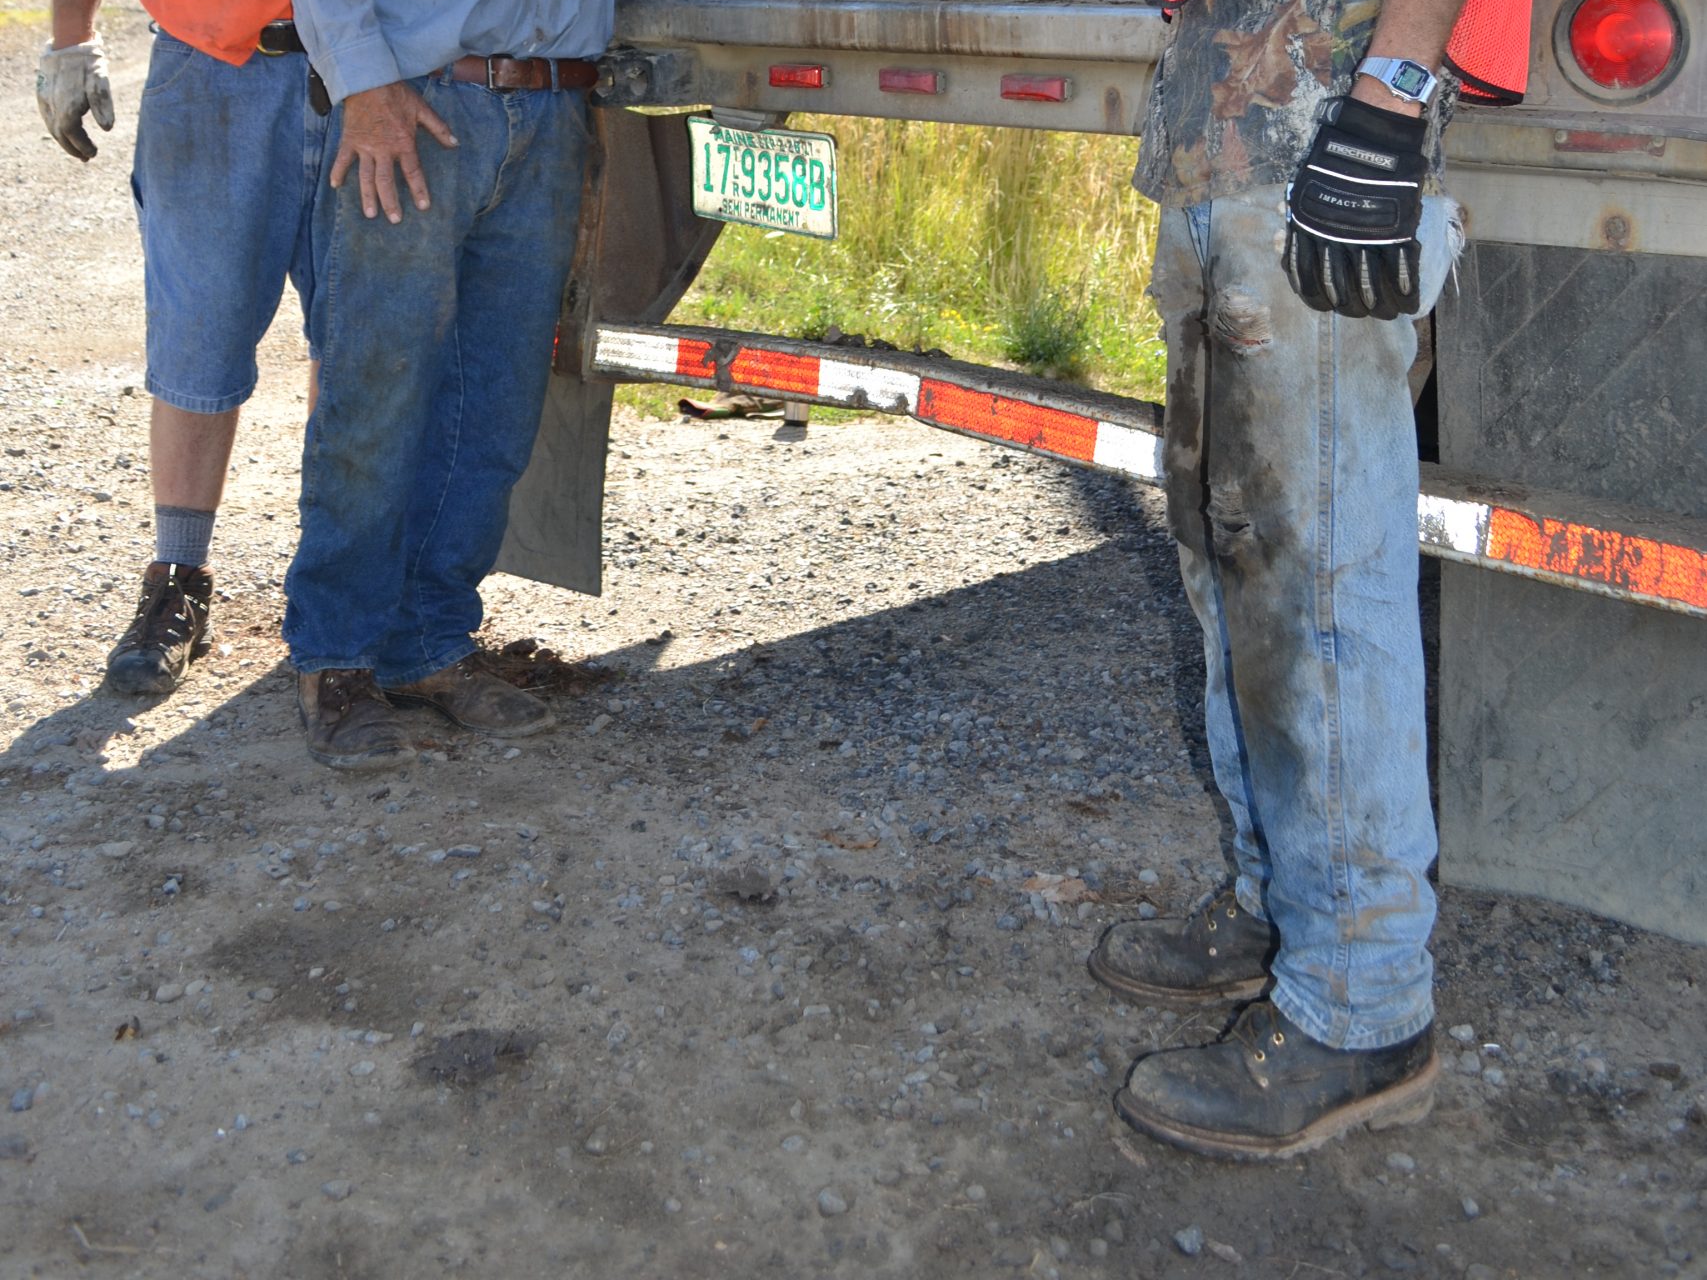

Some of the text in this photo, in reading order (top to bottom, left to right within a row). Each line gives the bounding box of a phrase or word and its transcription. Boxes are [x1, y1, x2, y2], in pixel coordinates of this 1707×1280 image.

[714, 129, 758, 148] MAINE
[722, 198, 800, 227] SEMI PERMANENT
